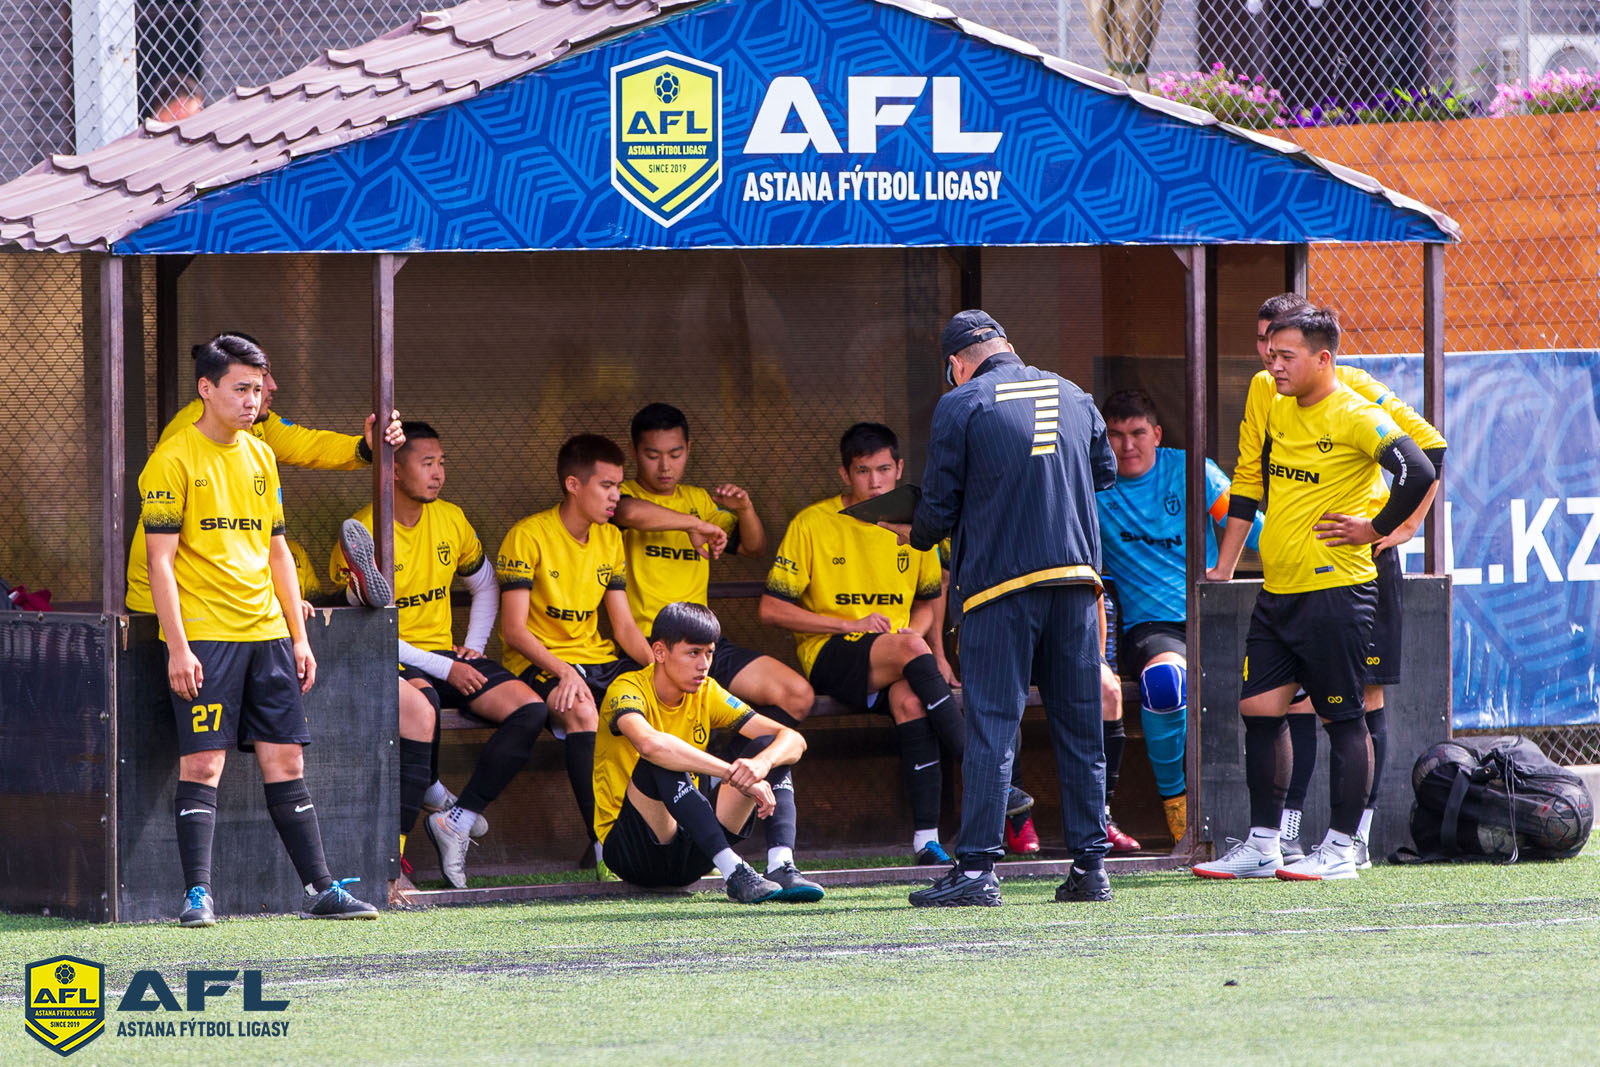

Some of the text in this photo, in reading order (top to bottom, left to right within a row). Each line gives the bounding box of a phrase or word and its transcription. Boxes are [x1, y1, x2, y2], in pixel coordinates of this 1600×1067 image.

[743, 76, 1002, 153] AFL
[627, 111, 708, 134] AFL
[628, 145, 656, 155] ASTANA
[682, 145, 707, 155] LIGASY
[648, 164, 687, 173] SINCE 2019
[743, 164, 1002, 201] ASTANA FÝTBOL LIGASY
[1269, 463, 1320, 485] SEVEN
[147, 490, 175, 500] AFL
[200, 517, 262, 531] SEVEN
[508, 559, 532, 570] AFL
[835, 593, 904, 605] SEVEN
[191, 703, 223, 733] 27
